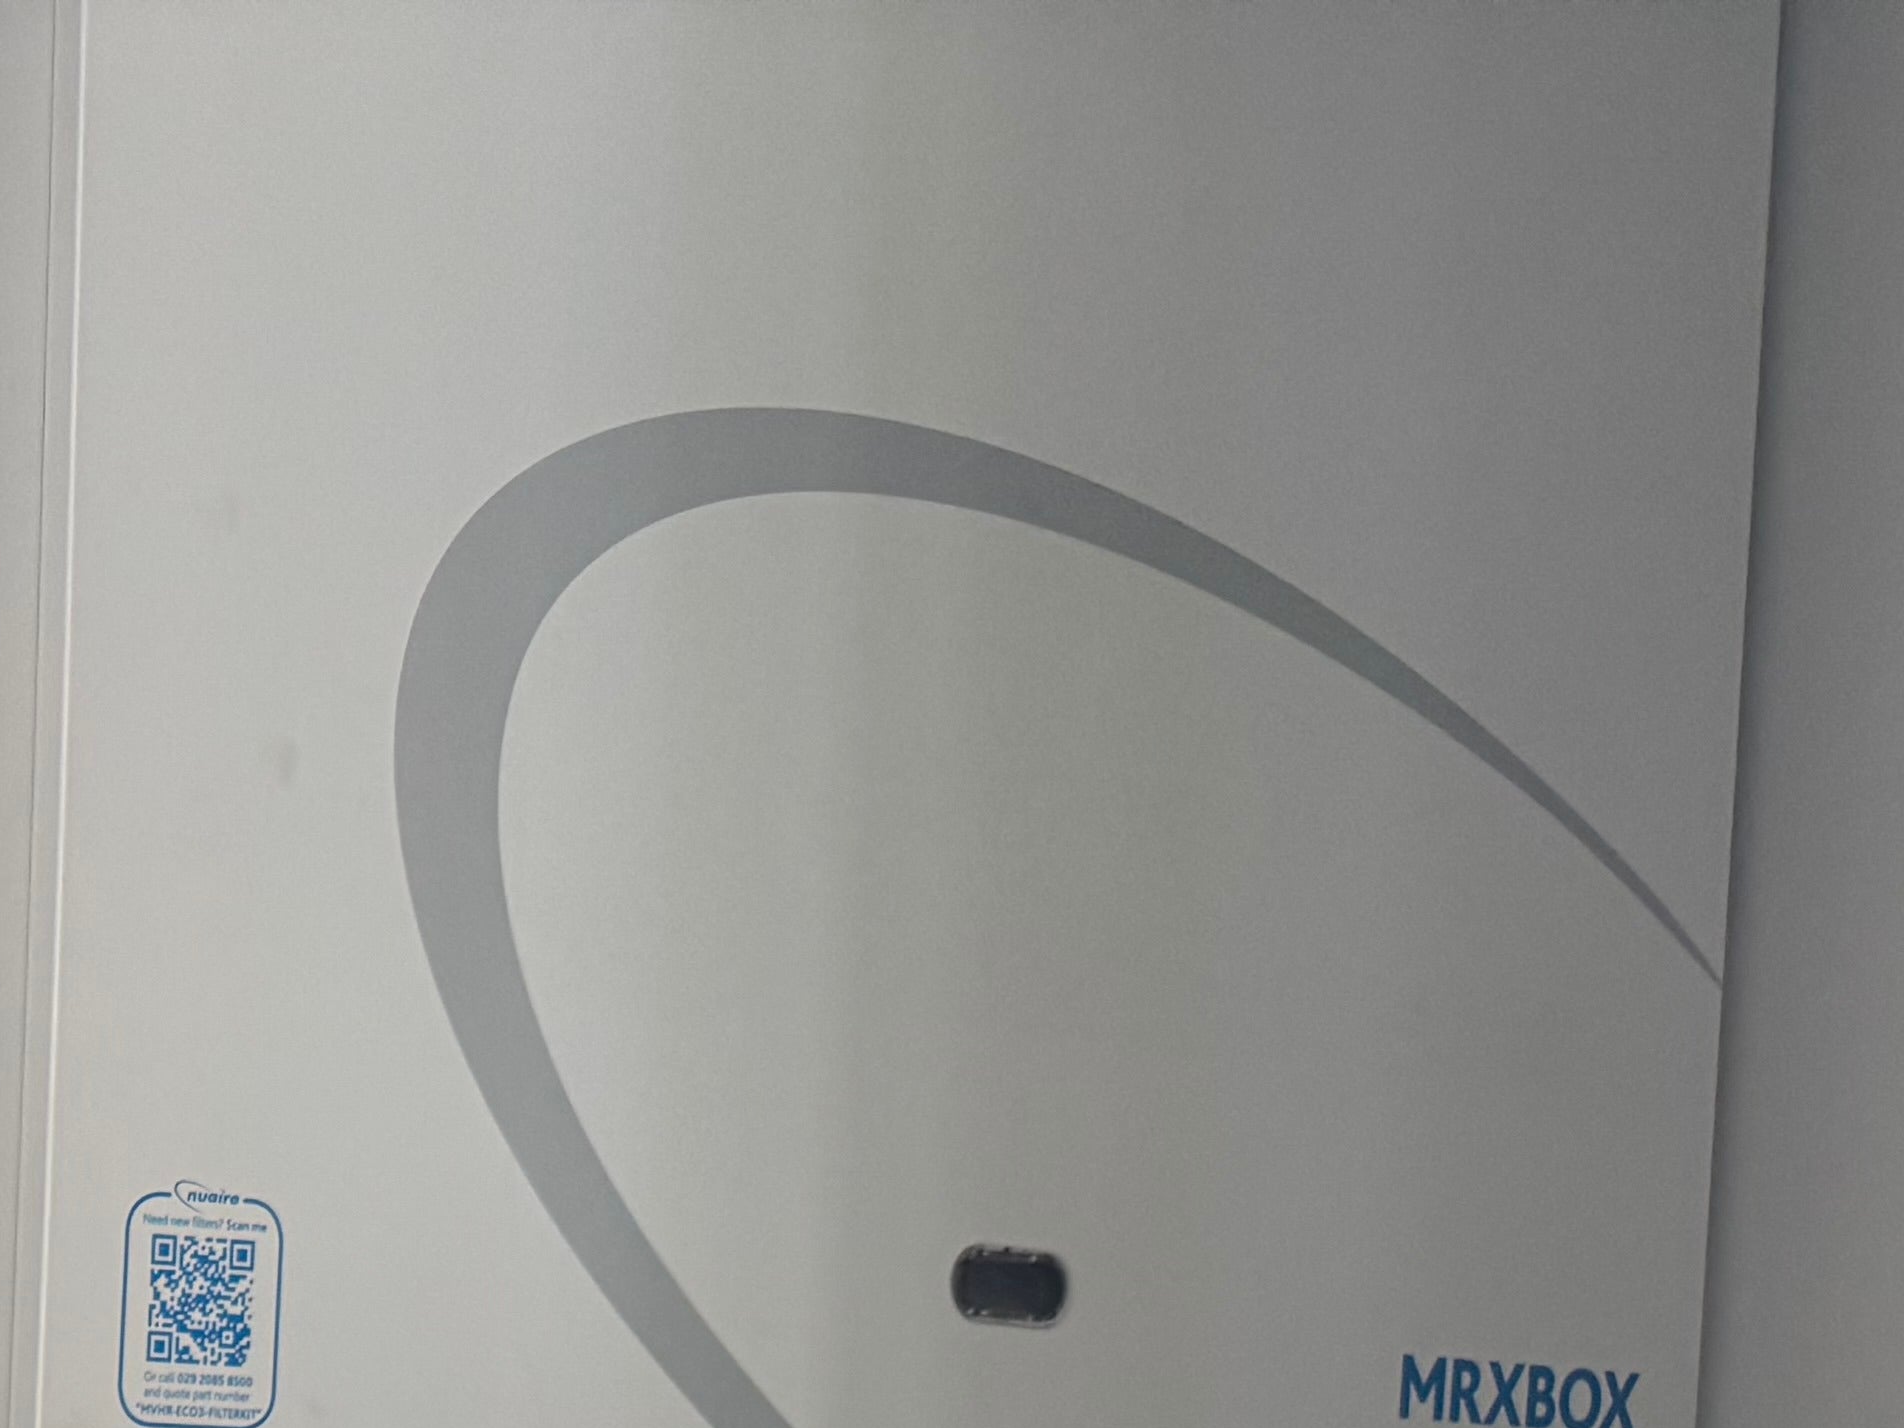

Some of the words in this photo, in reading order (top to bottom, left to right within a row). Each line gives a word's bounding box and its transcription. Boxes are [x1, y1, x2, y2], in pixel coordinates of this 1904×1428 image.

[187, 1188, 240, 1205] nuaire
[226, 1219, 250, 1231] Scan
[252, 1222, 267, 1232] me
[144, 1387, 161, 1398] and
[163, 1388, 191, 1400] quote
[214, 1391, 250, 1402] number
